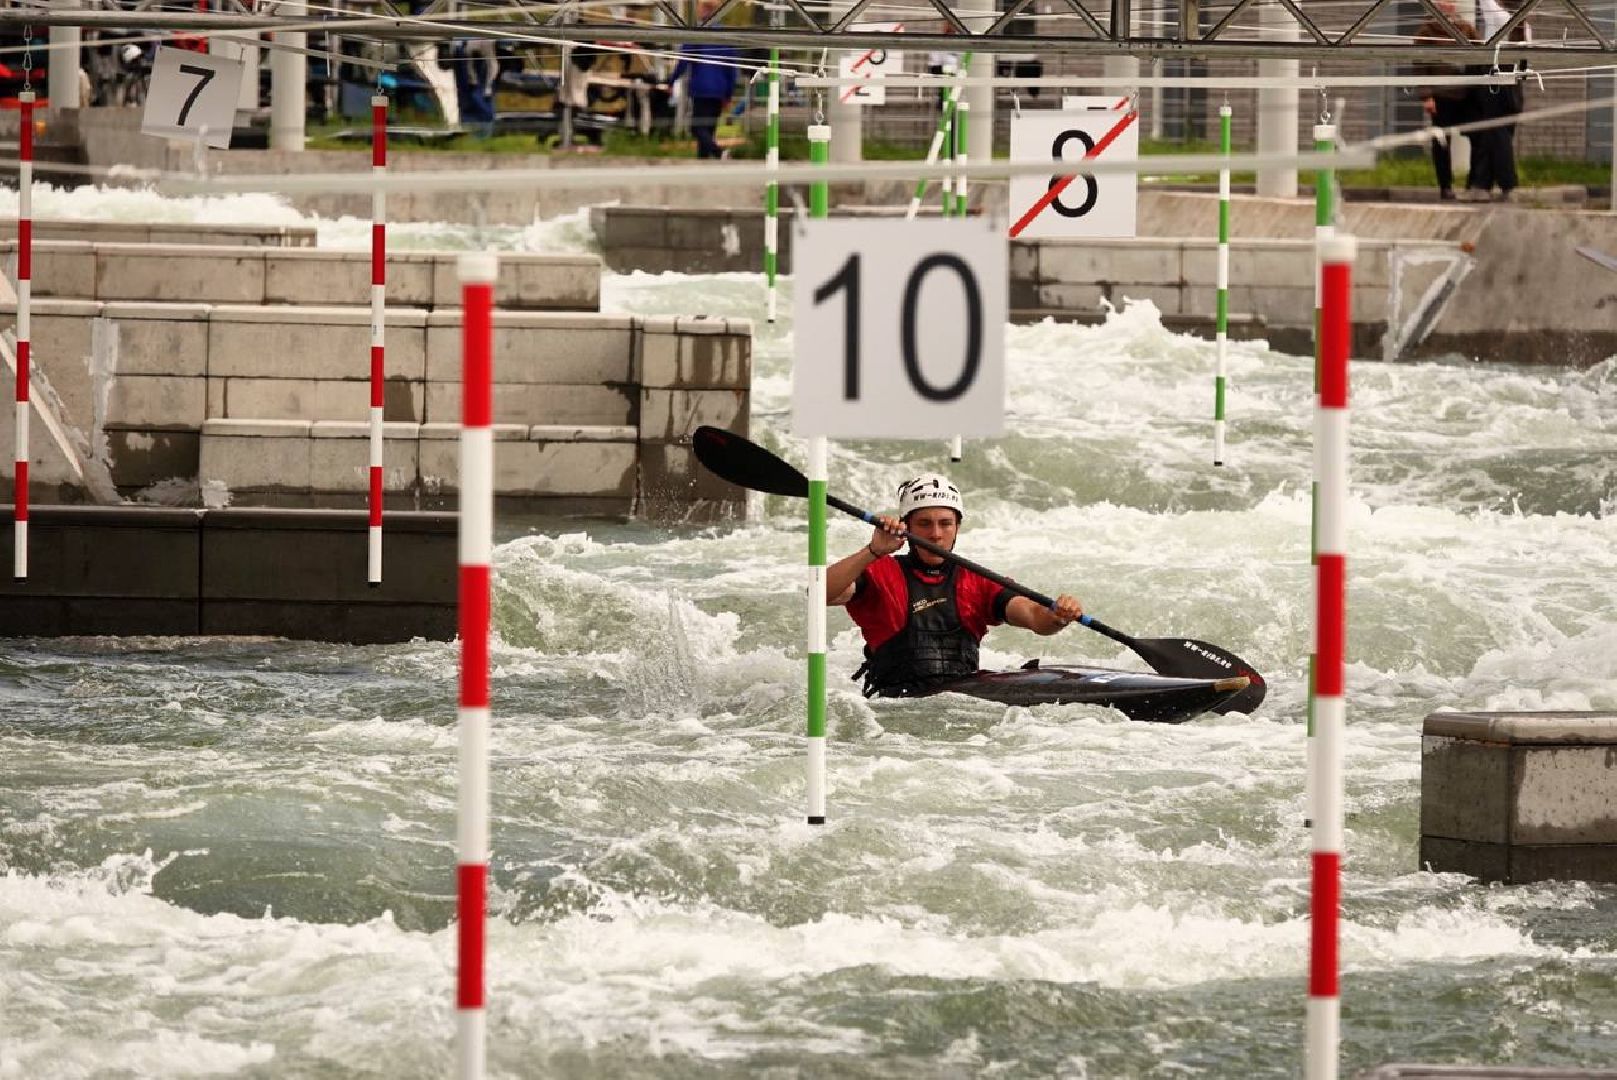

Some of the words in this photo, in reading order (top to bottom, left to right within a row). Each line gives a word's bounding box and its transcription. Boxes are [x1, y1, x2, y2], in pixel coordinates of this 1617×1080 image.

[178, 64, 216, 126] 7
[1048, 129, 1098, 218] 8
[812, 251, 984, 402] 10
